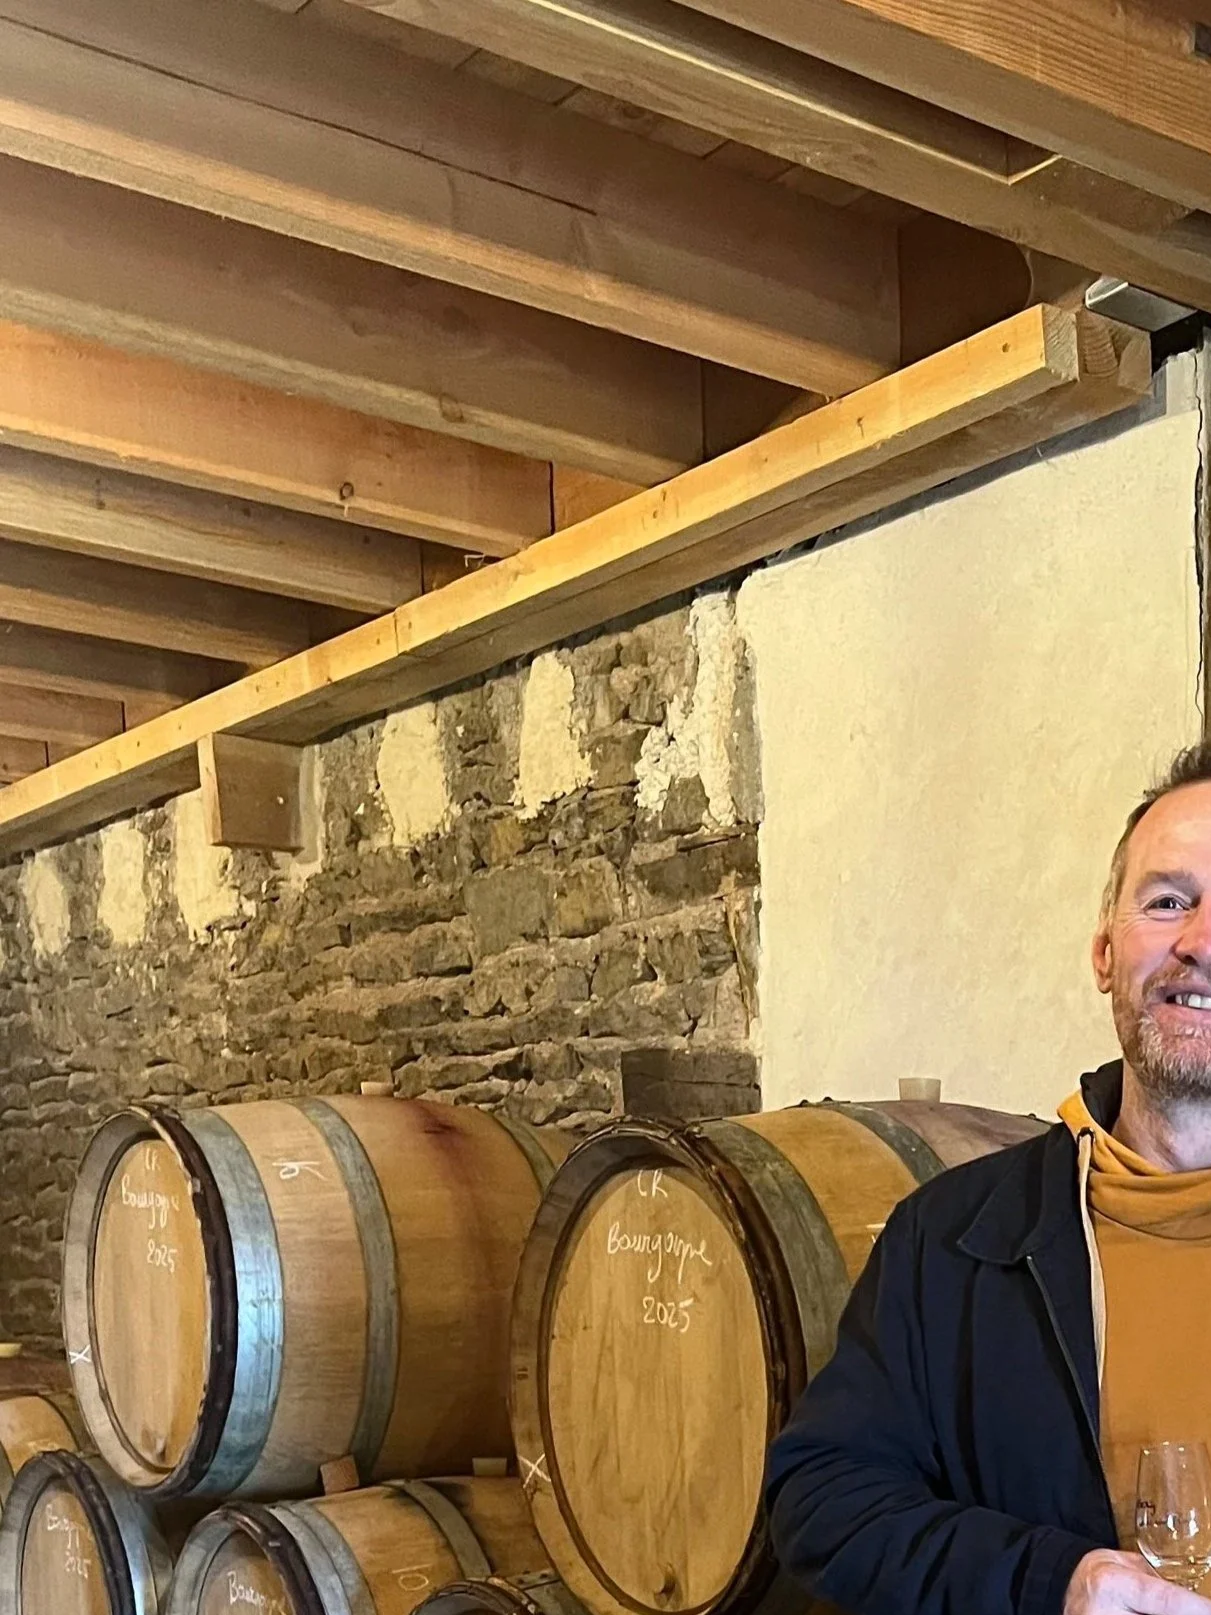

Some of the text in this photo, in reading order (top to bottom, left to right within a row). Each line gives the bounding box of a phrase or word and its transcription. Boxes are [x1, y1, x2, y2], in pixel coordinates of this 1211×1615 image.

[146, 1238, 178, 1273] 2025
[607, 1221, 713, 1285] Bourgogne
[642, 1296, 694, 1333] 2025
